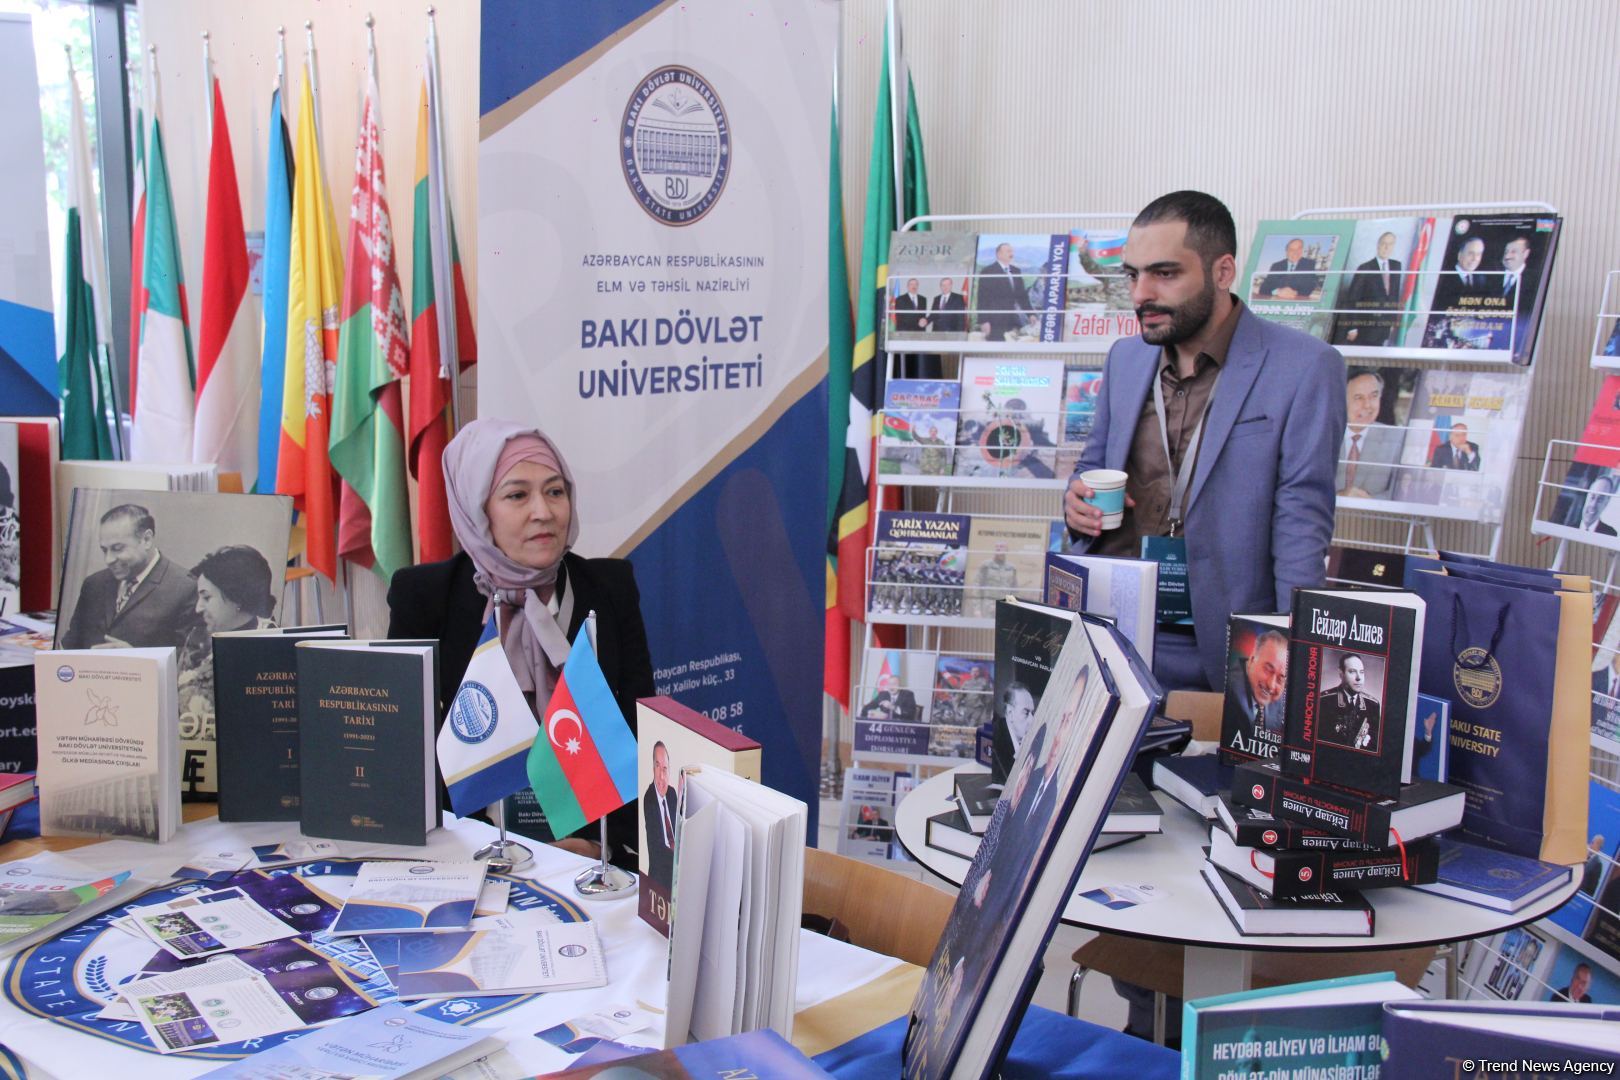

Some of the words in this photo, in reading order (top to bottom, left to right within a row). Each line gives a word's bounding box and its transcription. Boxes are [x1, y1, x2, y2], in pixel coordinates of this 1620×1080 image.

[627, 97, 643, 127] BAKI
[642, 72, 676, 97] DÖVLƏT
[626, 159, 643, 193] BAKU
[645, 197, 672, 220] STATE
[679, 165, 726, 220] UNIVERSITY
[898, 245, 952, 256] ZƏFƏR
[1053, 241, 1065, 262] YOL
[582, 254, 661, 267] AZƏRBAYCAN
[666, 253, 765, 268] RESPUBLİKASININ
[597, 281, 622, 293] ELM
[629, 281, 646, 292] VƏ
[651, 278, 691, 292] TƏHSİL
[696, 278, 750, 293] NAZİRLİYİ
[1048, 264, 1062, 305] APARAN
[1458, 296, 1483, 306] MƏN
[1483, 297, 1507, 306] ONA
[581, 319, 648, 349] BAKI
[655, 309, 763, 346] DÖVLƏT
[1117, 313, 1142, 336] Yol
[579, 353, 764, 400] UNİVERSİTETİ
[890, 518, 922, 530] TARİX
[925, 520, 960, 532] YAZAN
[1310, 608, 1347, 647] Гейдар
[1349, 614, 1384, 645] Алиев
[653, 662, 688, 680] rbaycan
[689, 652, 742, 671] Respublikası,
[256, 672, 297, 681] AZƏRBA
[656, 684, 671, 697] hid
[724, 669, 735, 681] 33
[245, 685, 297, 696] RESPUBLİK
[329, 686, 389, 697] AZƏRBAYCAN
[0, 693, 36, 709] oyski
[271, 699, 296, 708] TARİ
[319, 699, 399, 713] RESPUBLİKASININ
[711, 706, 728, 722] 08
[730, 701, 743, 717] 58
[343, 715, 375, 726] TARİXİ
[869, 723, 882, 733] 44
[1254, 725, 1282, 744] Гейда
[1472, 725, 1502, 742] STATE
[1230, 729, 1280, 758] Алие
[1450, 736, 1500, 758] NIVERSITY
[287, 748, 292, 759] I
[0, 761, 21, 773] ary
[355, 766, 365, 777] II
[1282, 800, 1314, 818] Алиев
[1315, 810, 1349, 830] Гейдар
[1302, 839, 1340, 850] Алиев
[1333, 870, 1365, 880] Алиев
[1367, 866, 1401, 878] Гейдар
[34, 954, 76, 1010] STATE
[1213, 1043, 1262, 1060] HEYDƏR
[1264, 1037, 1307, 1058] ƏLİYEV
[1310, 1040, 1325, 1054] VƏ
[1327, 1034, 1366, 1053] İLHAM
[1368, 1034, 1382, 1051] ƏL
